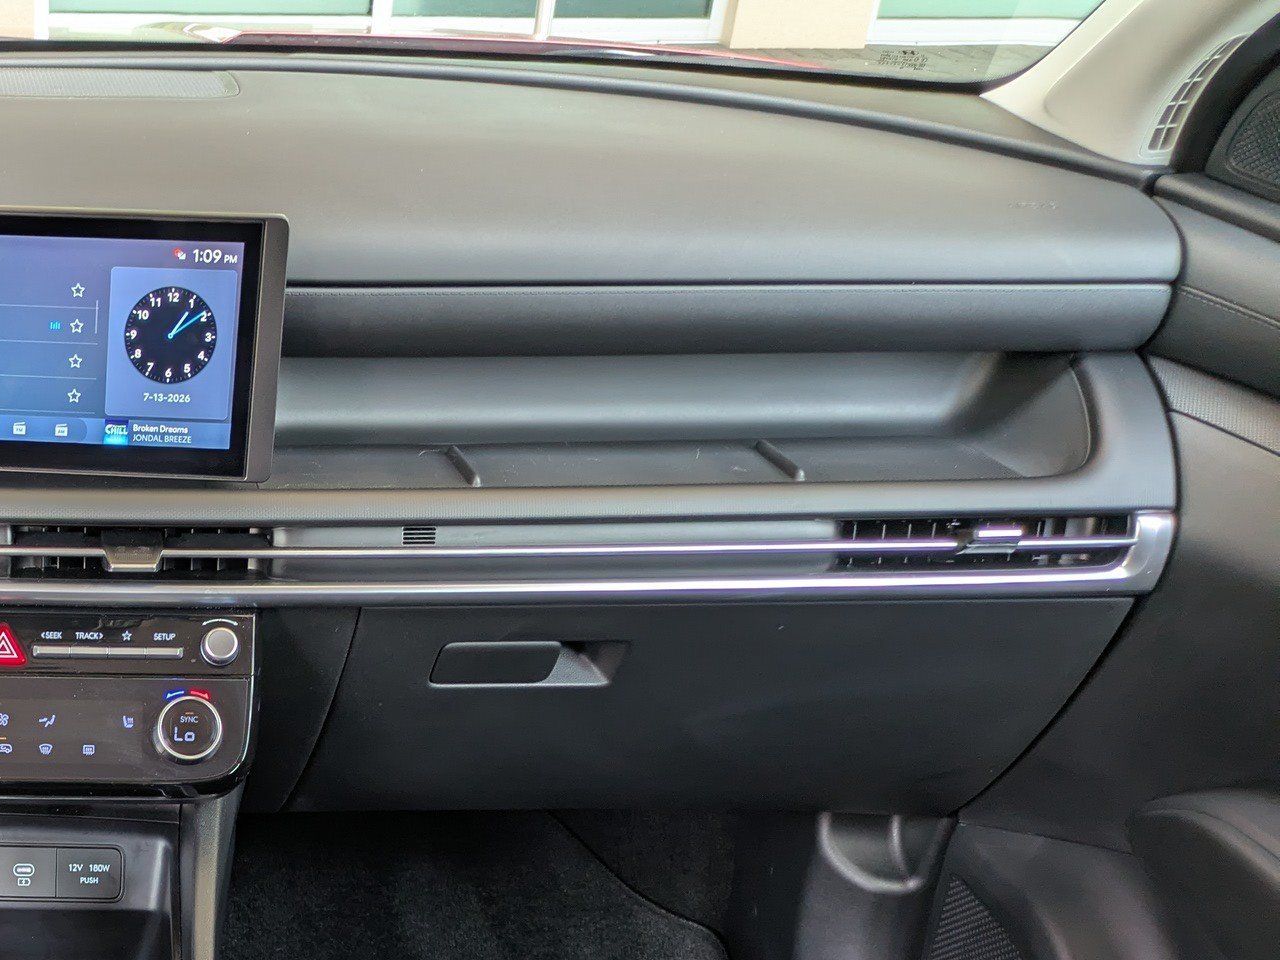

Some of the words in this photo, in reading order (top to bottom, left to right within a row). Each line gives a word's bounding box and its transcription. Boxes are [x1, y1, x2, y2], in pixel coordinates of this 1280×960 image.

[193, 249, 222, 263] 1:09
[223, 254, 238, 264] PM
[150, 297, 161, 307] 11
[167, 292, 180, 303] 12
[188, 298, 195, 308] 1
[137, 310, 149, 320] 10
[200, 311, 208, 322] 2
[130, 329, 137, 339] 9
[205, 332, 212, 342] 3
[134, 349, 142, 359] 8
[197, 350, 205, 360] 4
[147, 362, 154, 372] 7
[183, 363, 191, 373] 5
[165, 368, 172, 378] 6
[143, 392, 191, 403] 7-13-2026
[105, 423, 128, 435] CHILL
[132, 423, 159, 433] Broken
[160, 424, 189, 434] Dreams
[132, 433, 163, 442] JONDAL
[164, 435, 192, 444] BREEZE
[153, 632, 176, 641] SETUP
[180, 715, 199, 723] SYNC
[68, 864, 83, 872] 12V
[88, 864, 111, 873] 180W
